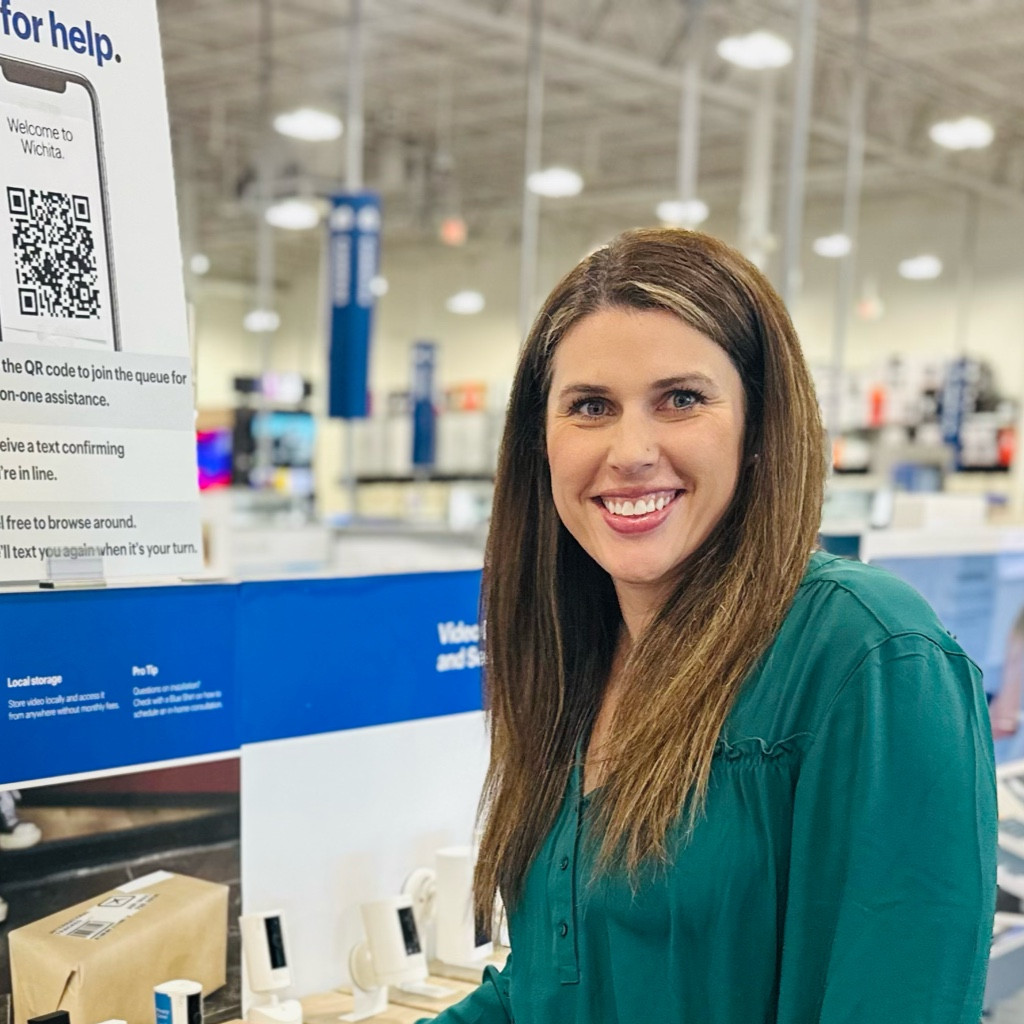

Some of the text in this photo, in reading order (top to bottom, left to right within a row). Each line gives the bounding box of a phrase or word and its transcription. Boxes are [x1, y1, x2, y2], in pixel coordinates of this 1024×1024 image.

[0, 4, 44, 42] for
[48, 10, 121, 66] help.
[7, 116, 74, 141] Welcome to
[21, 139, 65, 160] Wichita.
[2, 358, 22, 374] the
[24, 360, 44, 377] QR
[46, 363, 76, 378] code
[78, 364, 90, 379] to
[92, 366, 113, 382] join
[115, 366, 133, 381] the
[136, 371, 170, 386] queue
[172, 371, 187, 385] for
[44, 389, 110, 407] assistance.
[27, 442, 35, 453] a
[36, 439, 61, 454] text
[62, 440, 125, 459] confirming
[18, 467, 30, 480] in
[32, 466, 58, 481] line.
[6, 516, 31, 530] free
[32, 516, 46, 530] to
[48, 516, 92, 530] browse
[93, 515, 137, 529] around.
[13, 545, 37, 559] text
[40, 546, 61, 560] you
[63, 544, 95, 559] again
[96, 542, 127, 556] when
[128, 542, 145, 556] it's
[147, 544, 171, 557] your
[172, 542, 197, 555] turn.
[132, 664, 159, 677] Pro Tip
[7, 674, 63, 688] Local storage
[8, 699, 26, 709] Store
[27, 698, 45, 708] video
[46, 695, 65, 708] locally
[66, 694, 78, 704] and
[80, 693, 99, 703] access
[8, 711, 25, 720] from
[26, 708, 56, 720] anywhere
[57, 706, 80, 717] without
[81, 702, 105, 714] monthly
